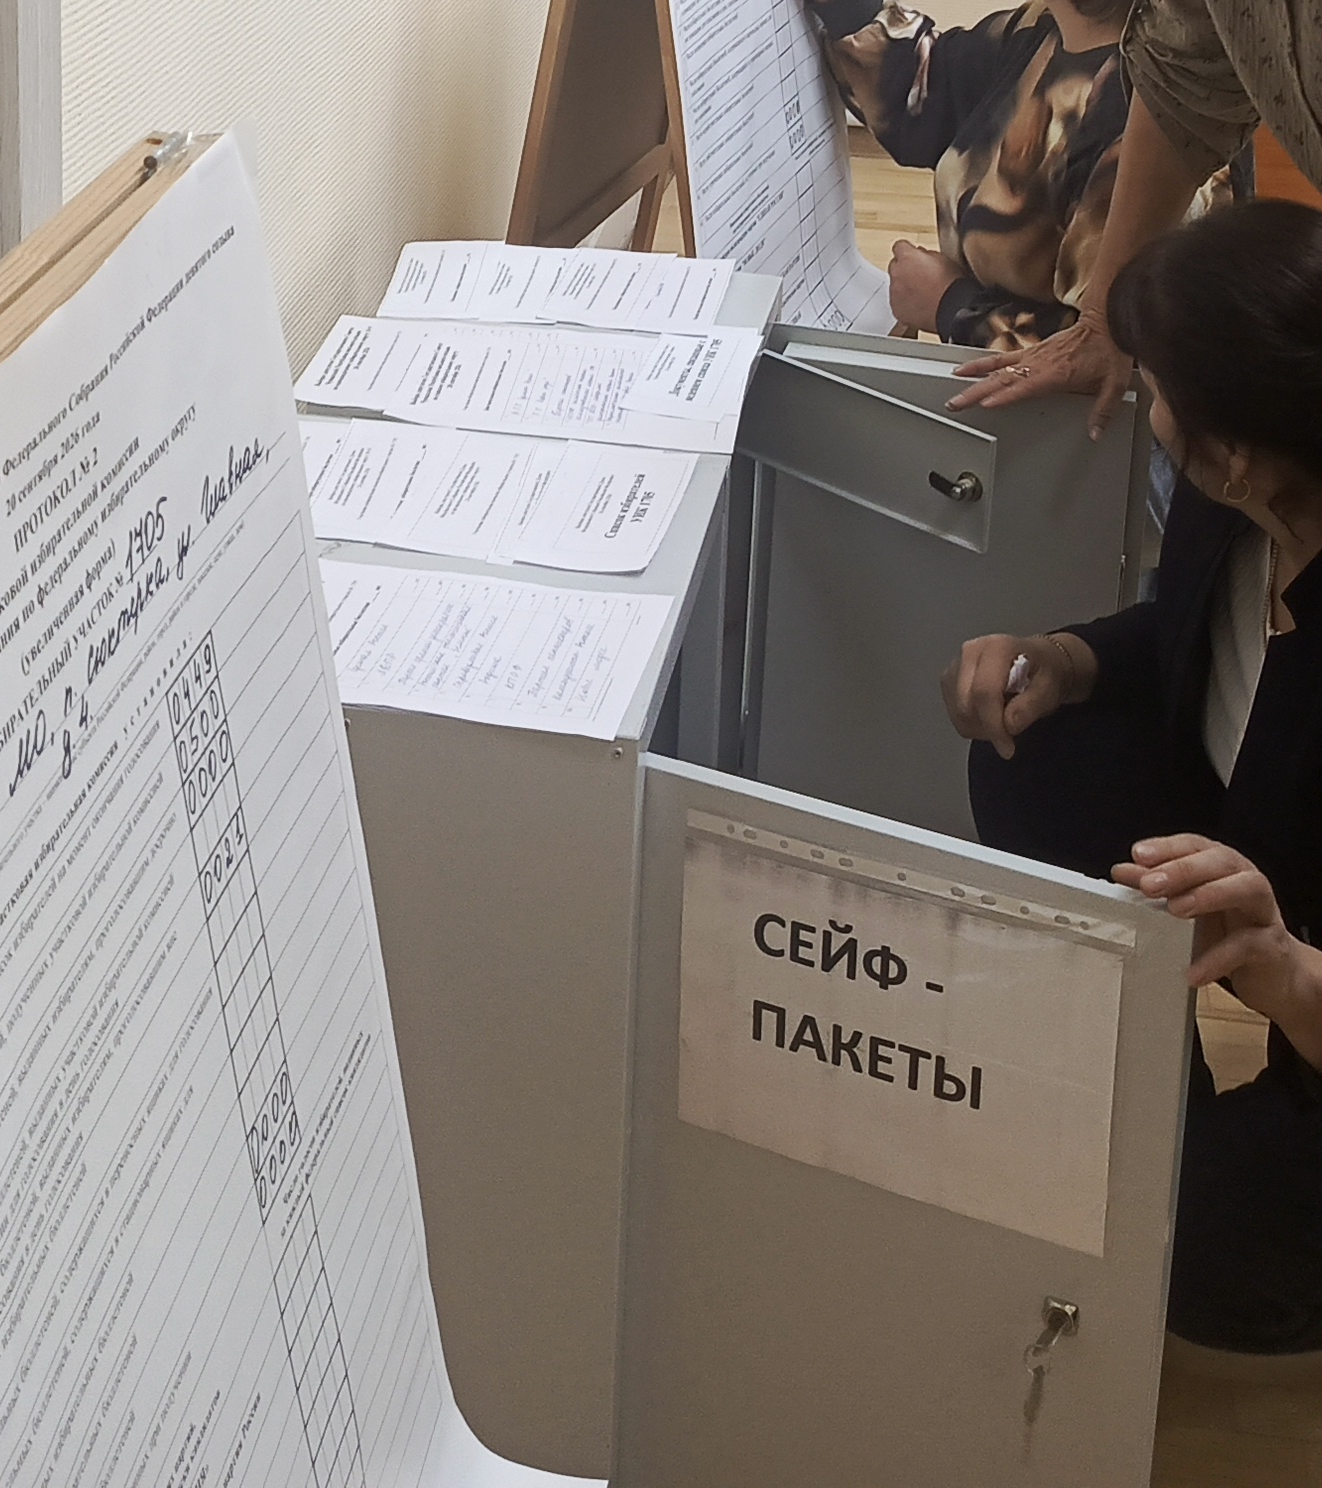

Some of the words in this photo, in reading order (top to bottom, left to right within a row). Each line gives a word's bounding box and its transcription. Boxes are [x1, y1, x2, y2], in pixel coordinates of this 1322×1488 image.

[1, 407, 67, 476] Федерального
[67, 363, 108, 412] Собрания
[108, 315, 145, 370] Российской
[145, 277, 184, 323] Федерации
[184, 248, 211, 285] девятого
[211, 225, 234, 254] созыва
[5, 492, 16, 517] 20
[17, 453, 58, 503] сентября
[60, 427, 79, 460] 2026
[81, 411, 100, 438] года
[13, 468, 80, 553] ПРОТОКОЛ
[21, 599, 35, 622] по
[36, 519, 98, 608] федеральному
[100, 436, 169, 523] избирательному
[170, 404, 195, 441] округу
[29, 481, 98, 576] избирательной
[99, 436, 139, 492] комиссии
[20, 583, 84, 676] (увеличенная
[84, 538, 115, 592] форма)
[71, 582, 114, 650] УЧАСТОК
[125, 497, 166, 583] 1705
[754, 913, 908, 991] СЕЙФ
[752, 999, 982, 1110] ПАКЕТЫ
